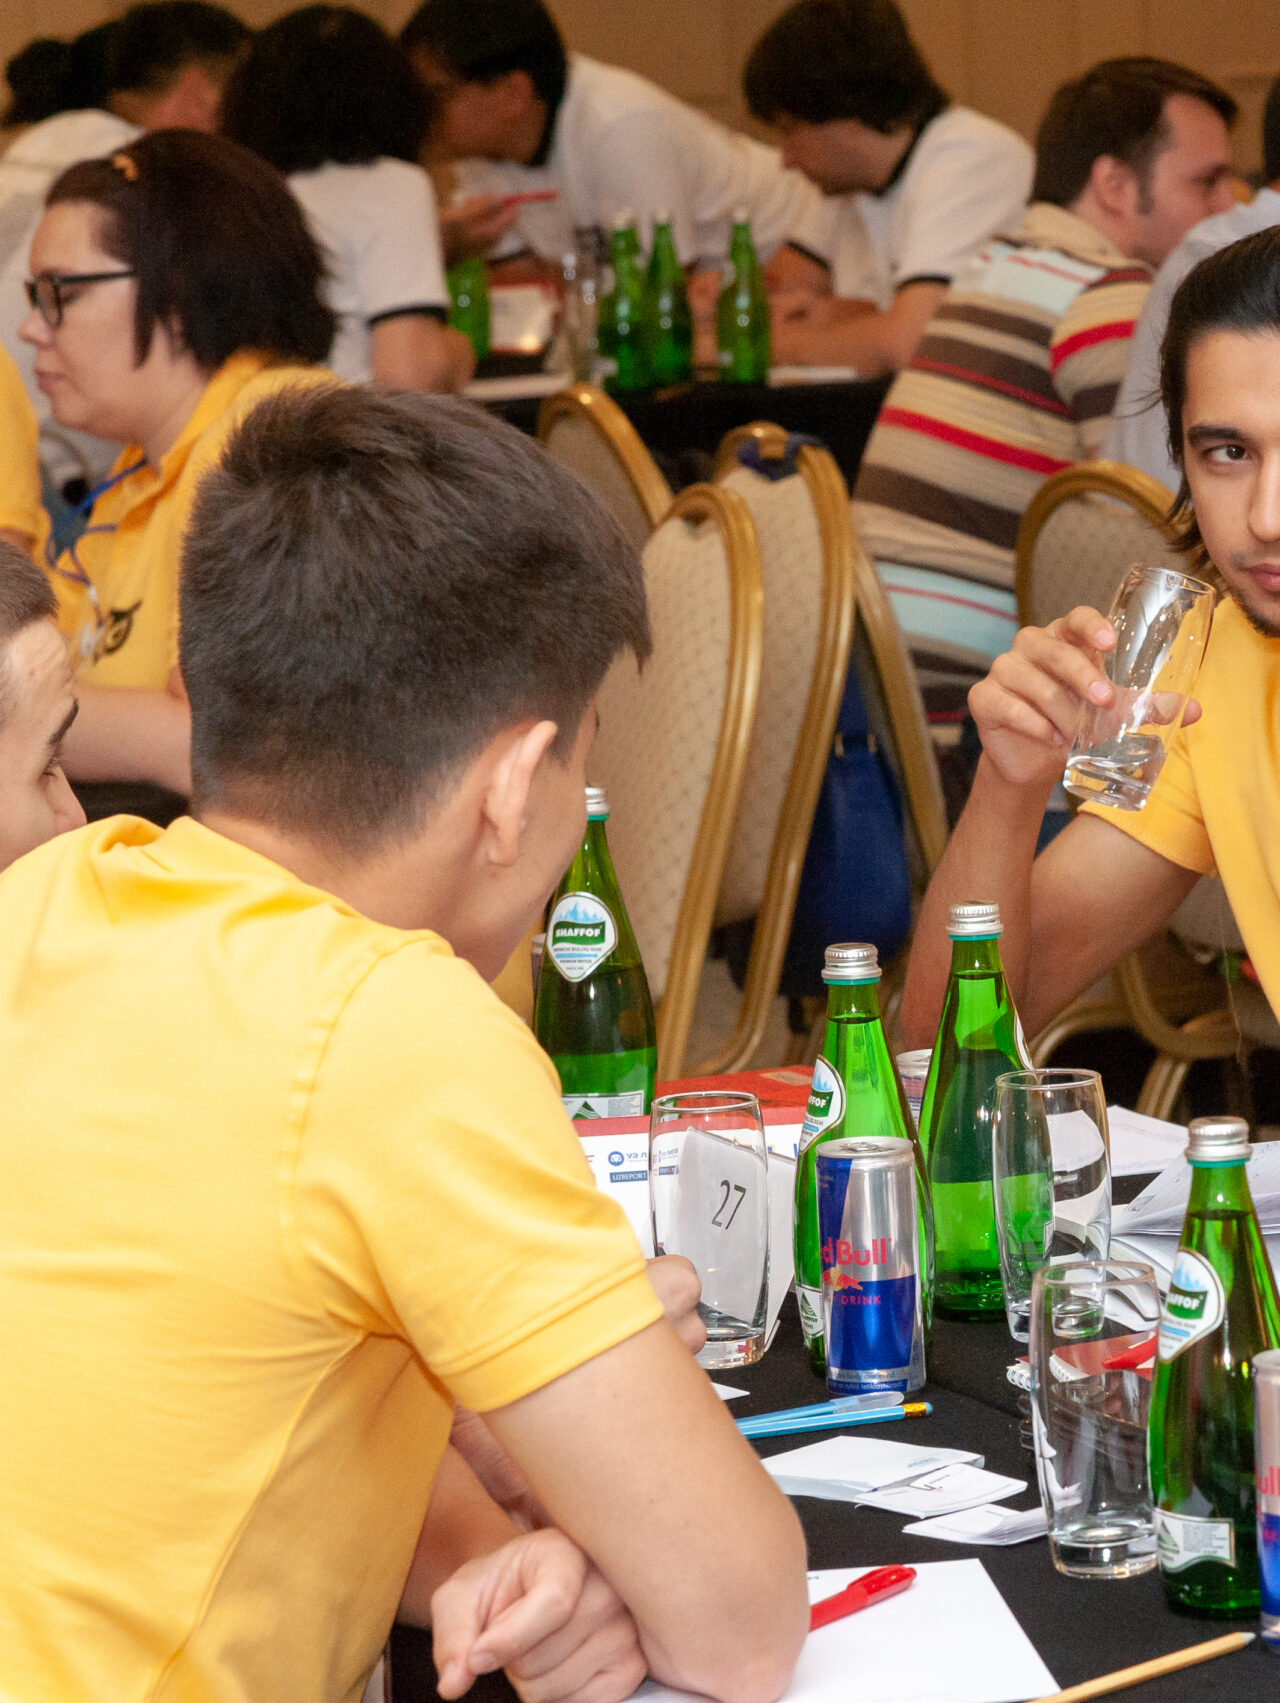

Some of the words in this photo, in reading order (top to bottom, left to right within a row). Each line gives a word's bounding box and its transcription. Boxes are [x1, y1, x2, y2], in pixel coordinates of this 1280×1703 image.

[555, 928, 601, 938] SHAFFOF
[712, 1179, 746, 1230] 27
[841, 1294, 882, 1306] DRINK
